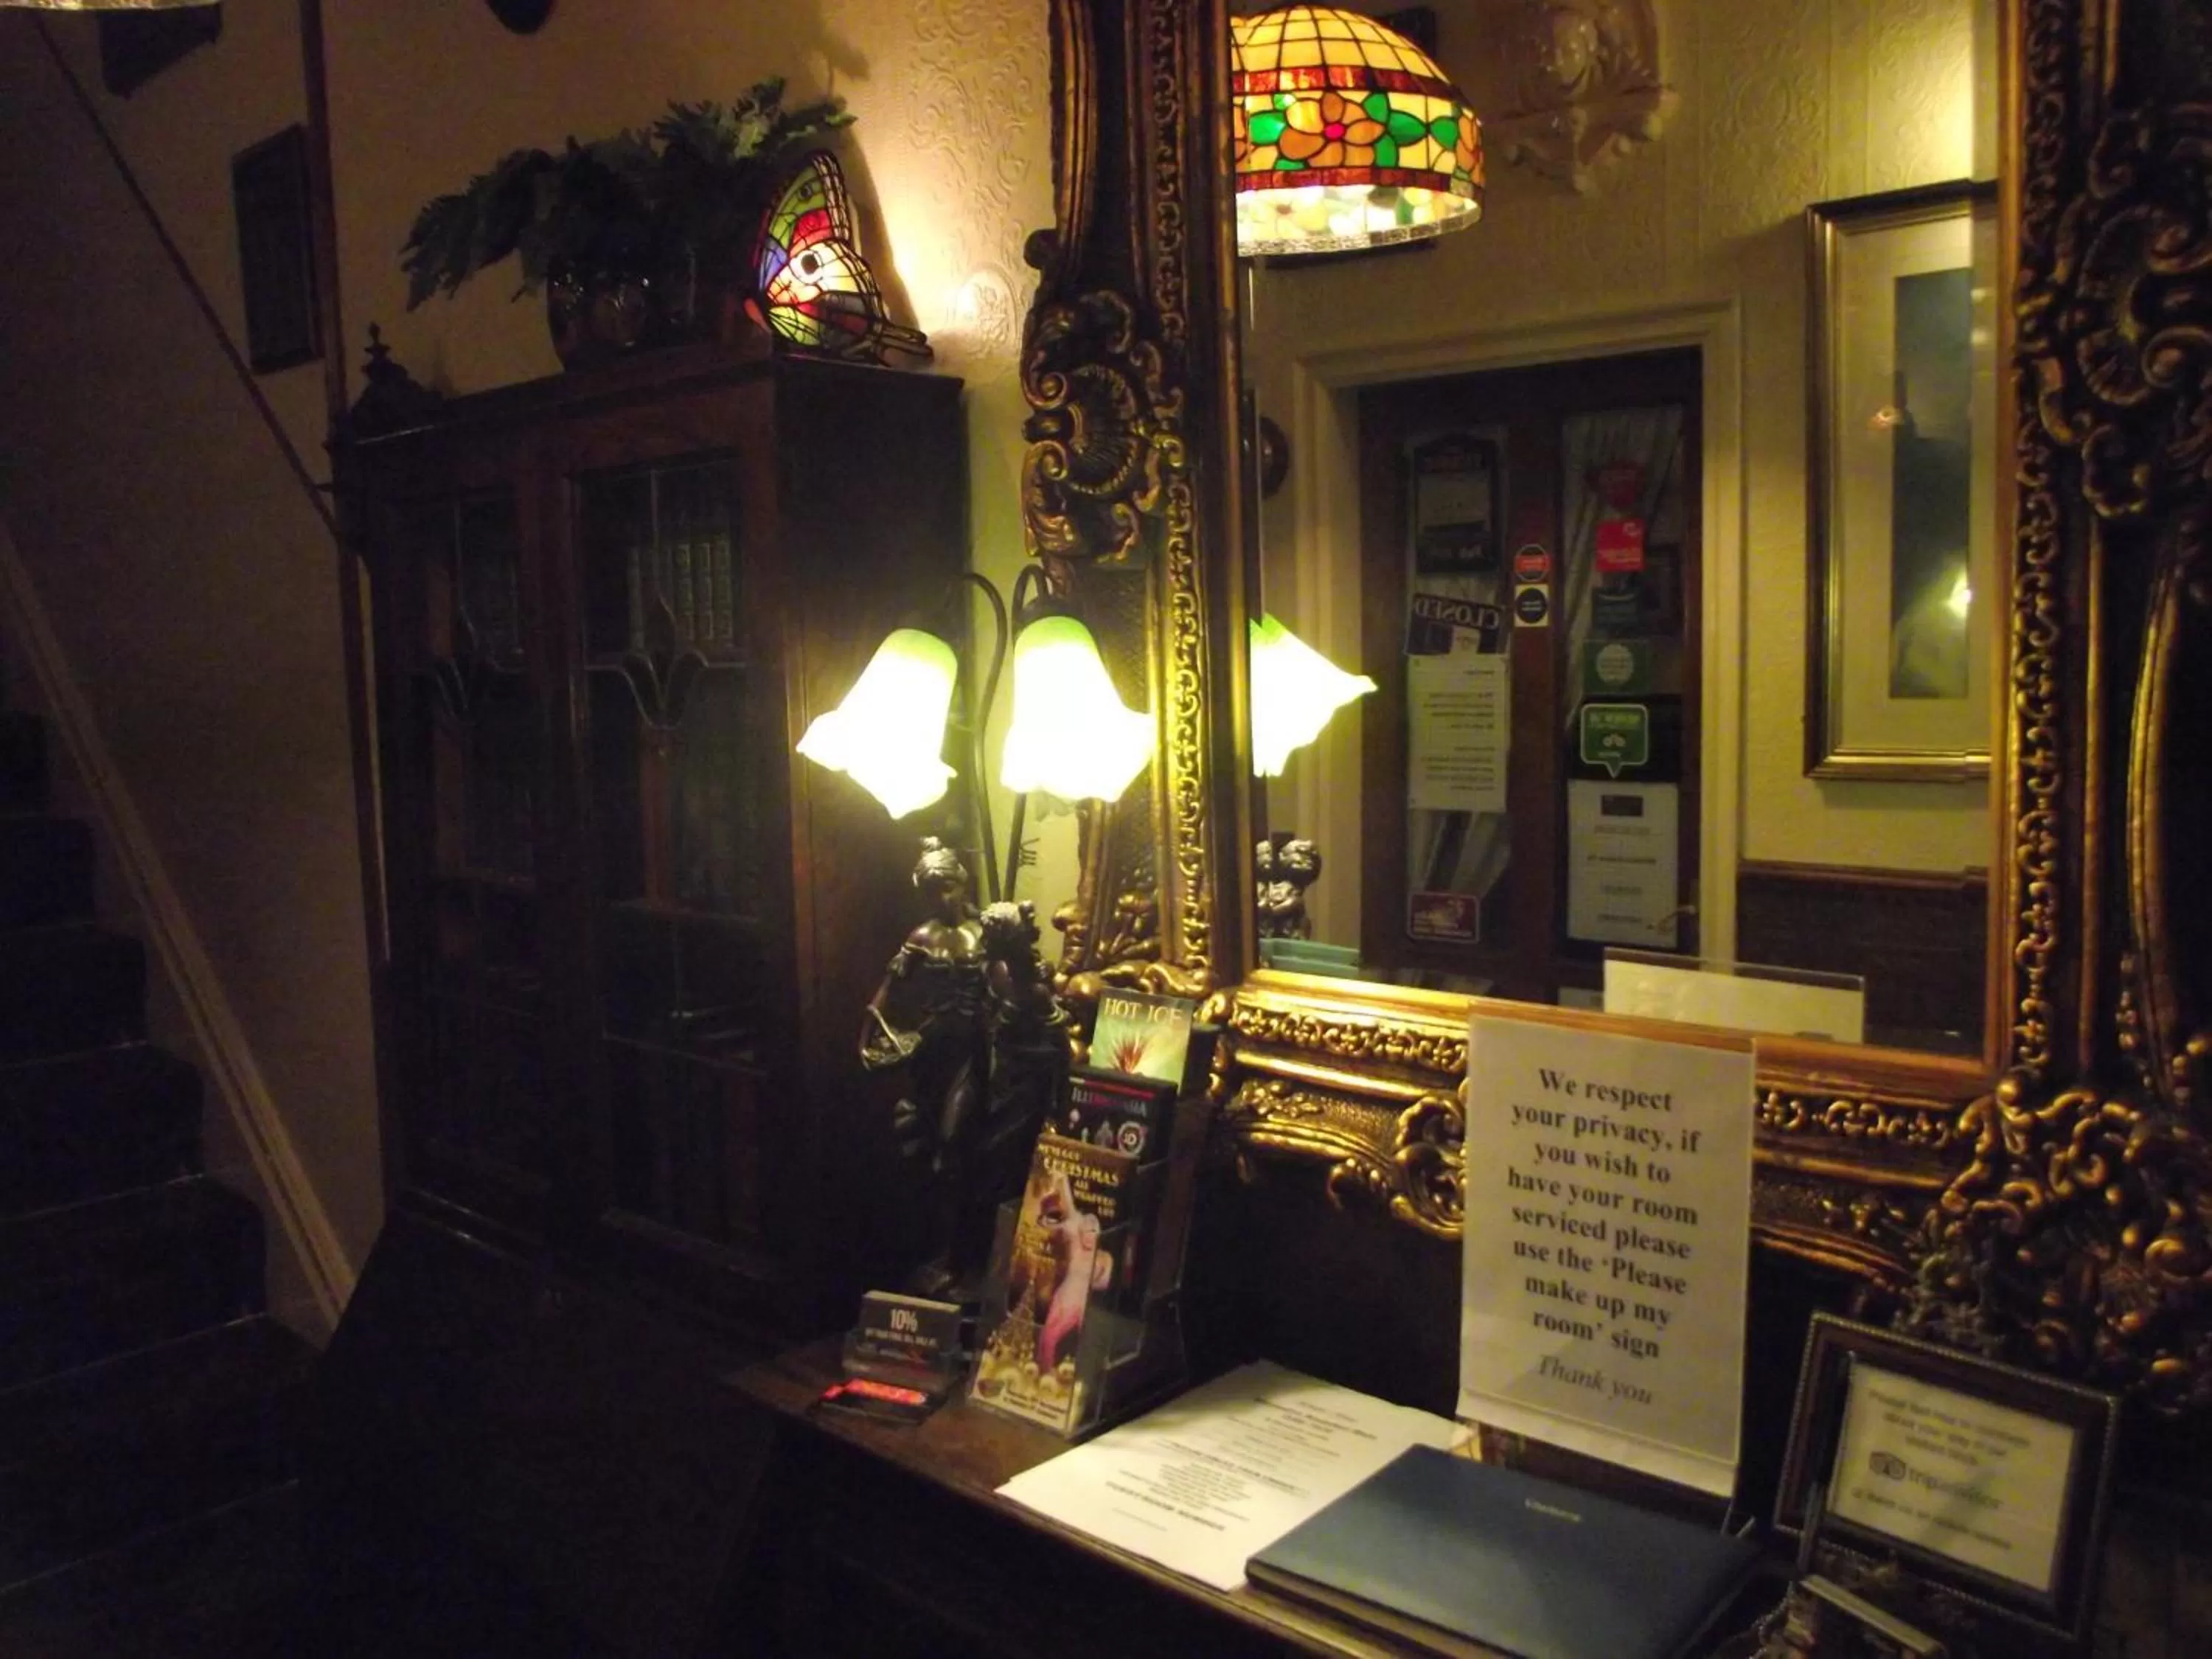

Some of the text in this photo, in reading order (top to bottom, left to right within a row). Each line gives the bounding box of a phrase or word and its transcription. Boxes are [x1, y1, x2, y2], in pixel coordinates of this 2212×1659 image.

[1105, 998, 1183, 1025] HOT ICE
[1539, 1068, 1674, 1111] We respect
[1512, 1105, 1701, 1152] your privacy, if
[1534, 1143, 1671, 1183] you wish to
[1508, 1166, 1698, 1225] have your room
[1512, 1207, 1691, 1259] serviced please
[1514, 1240, 1549, 1262] use
[1558, 1248, 1593, 1272] the
[890, 1308, 918, 1332] 10%
[1526, 1277, 1671, 1331] make up my
[1611, 1329, 1659, 1360] sign
[1540, 1354, 1652, 1405] Thank you
